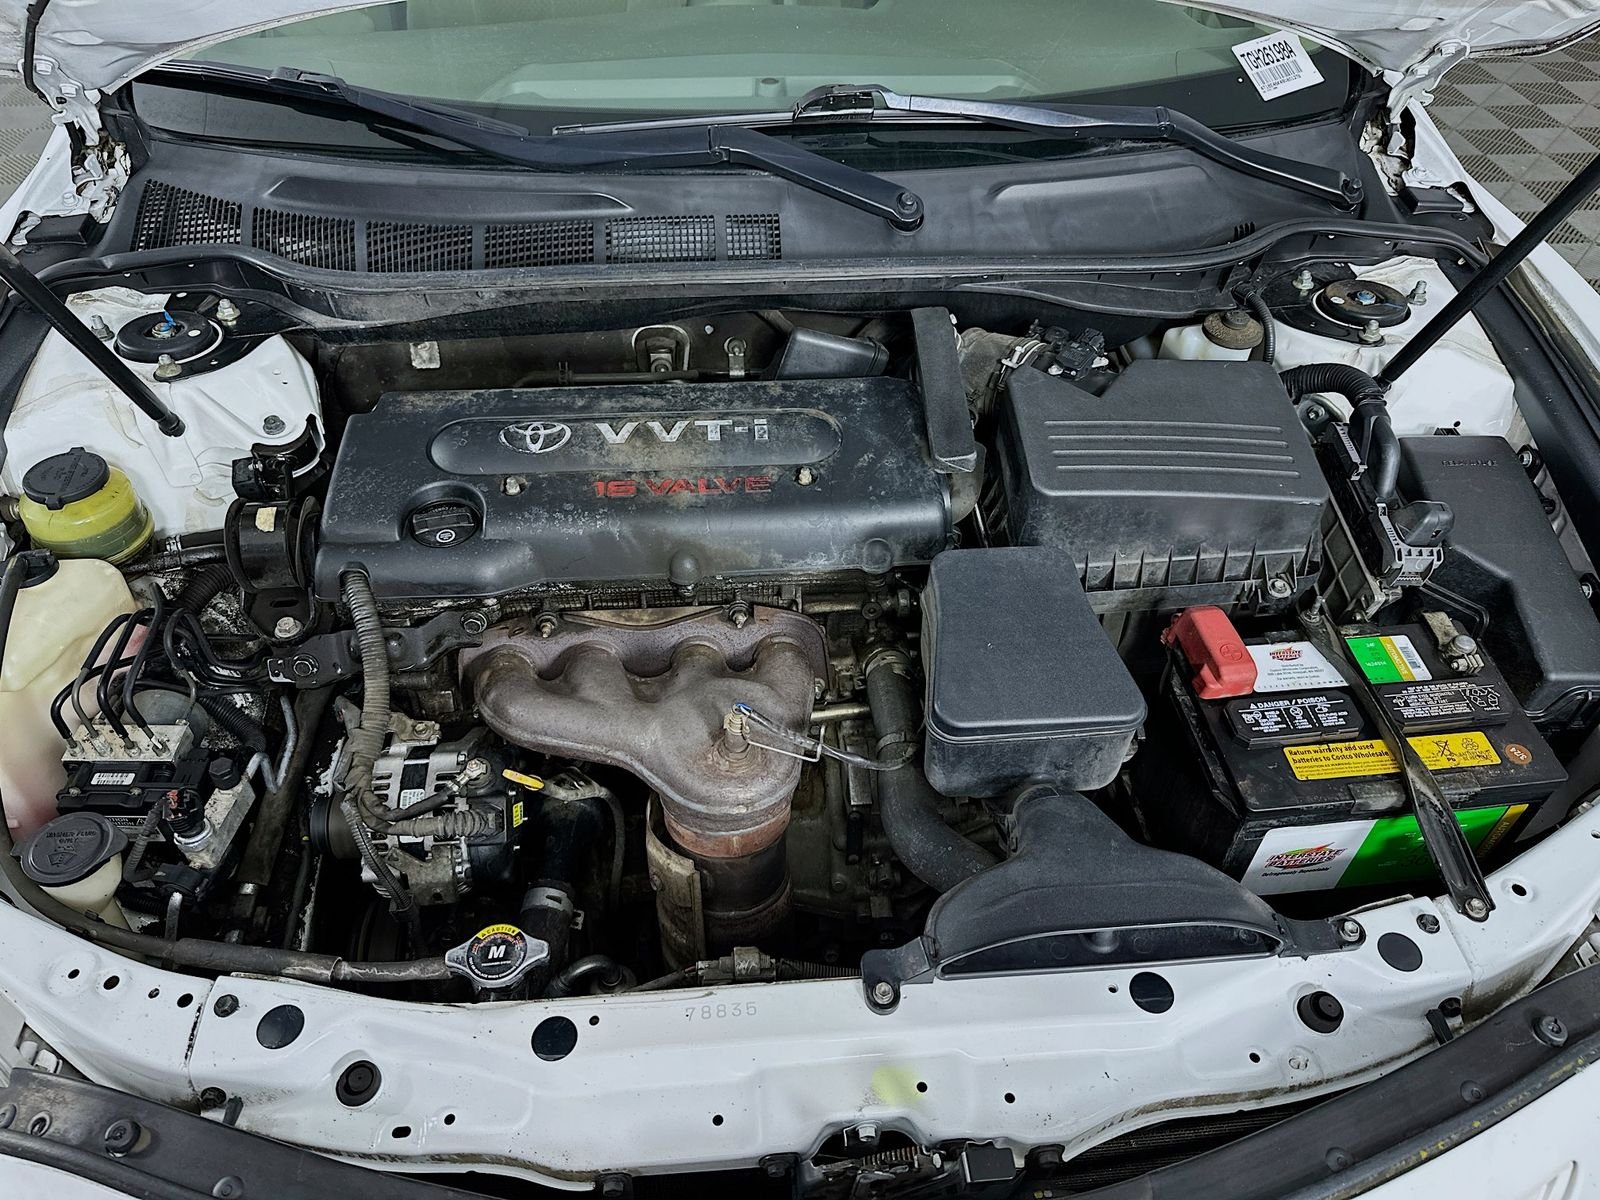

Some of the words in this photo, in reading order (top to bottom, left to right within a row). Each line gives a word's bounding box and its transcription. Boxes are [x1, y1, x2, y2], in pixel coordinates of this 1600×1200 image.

[1239, 40, 1297, 71] TGH26198A
[595, 419, 769, 444] VVT-i
[592, 479, 638, 498] 16
[644, 475, 773, 496] VALVE
[1256, 699, 1291, 709] DANGER
[1297, 696, 1328, 705] POISON
[1288, 747, 1312, 756] Return
[1313, 744, 1343, 755] warranty
[1344, 743, 1358, 751] and
[1358, 743, 1375, 751] used
[1291, 755, 1322, 764] batteries
[1331, 753, 1353, 761] Costco
[1353, 750, 1390, 759] Wholesale
[1267, 848, 1347, 861] INTERSTATE
[486, 926, 516, 935] CAUTION
[488, 944, 507, 960] M
[685, 1002, 757, 1021] 78835
